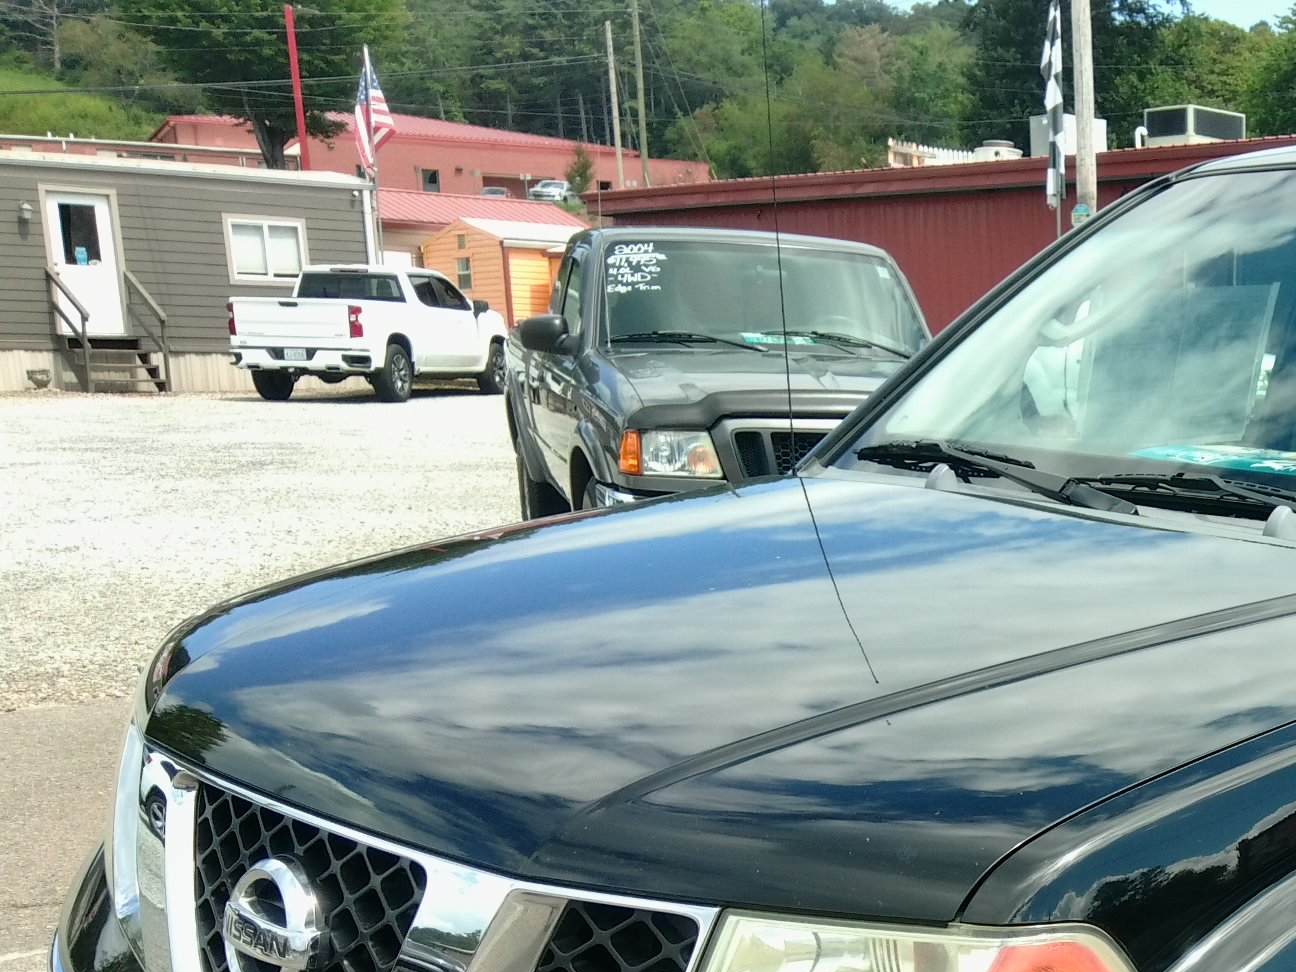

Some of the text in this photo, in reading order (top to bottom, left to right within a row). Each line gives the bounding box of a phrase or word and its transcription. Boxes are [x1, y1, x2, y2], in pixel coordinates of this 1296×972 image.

[614, 242, 654, 255] 2004
[606, 283, 662, 294] Edge Trim
